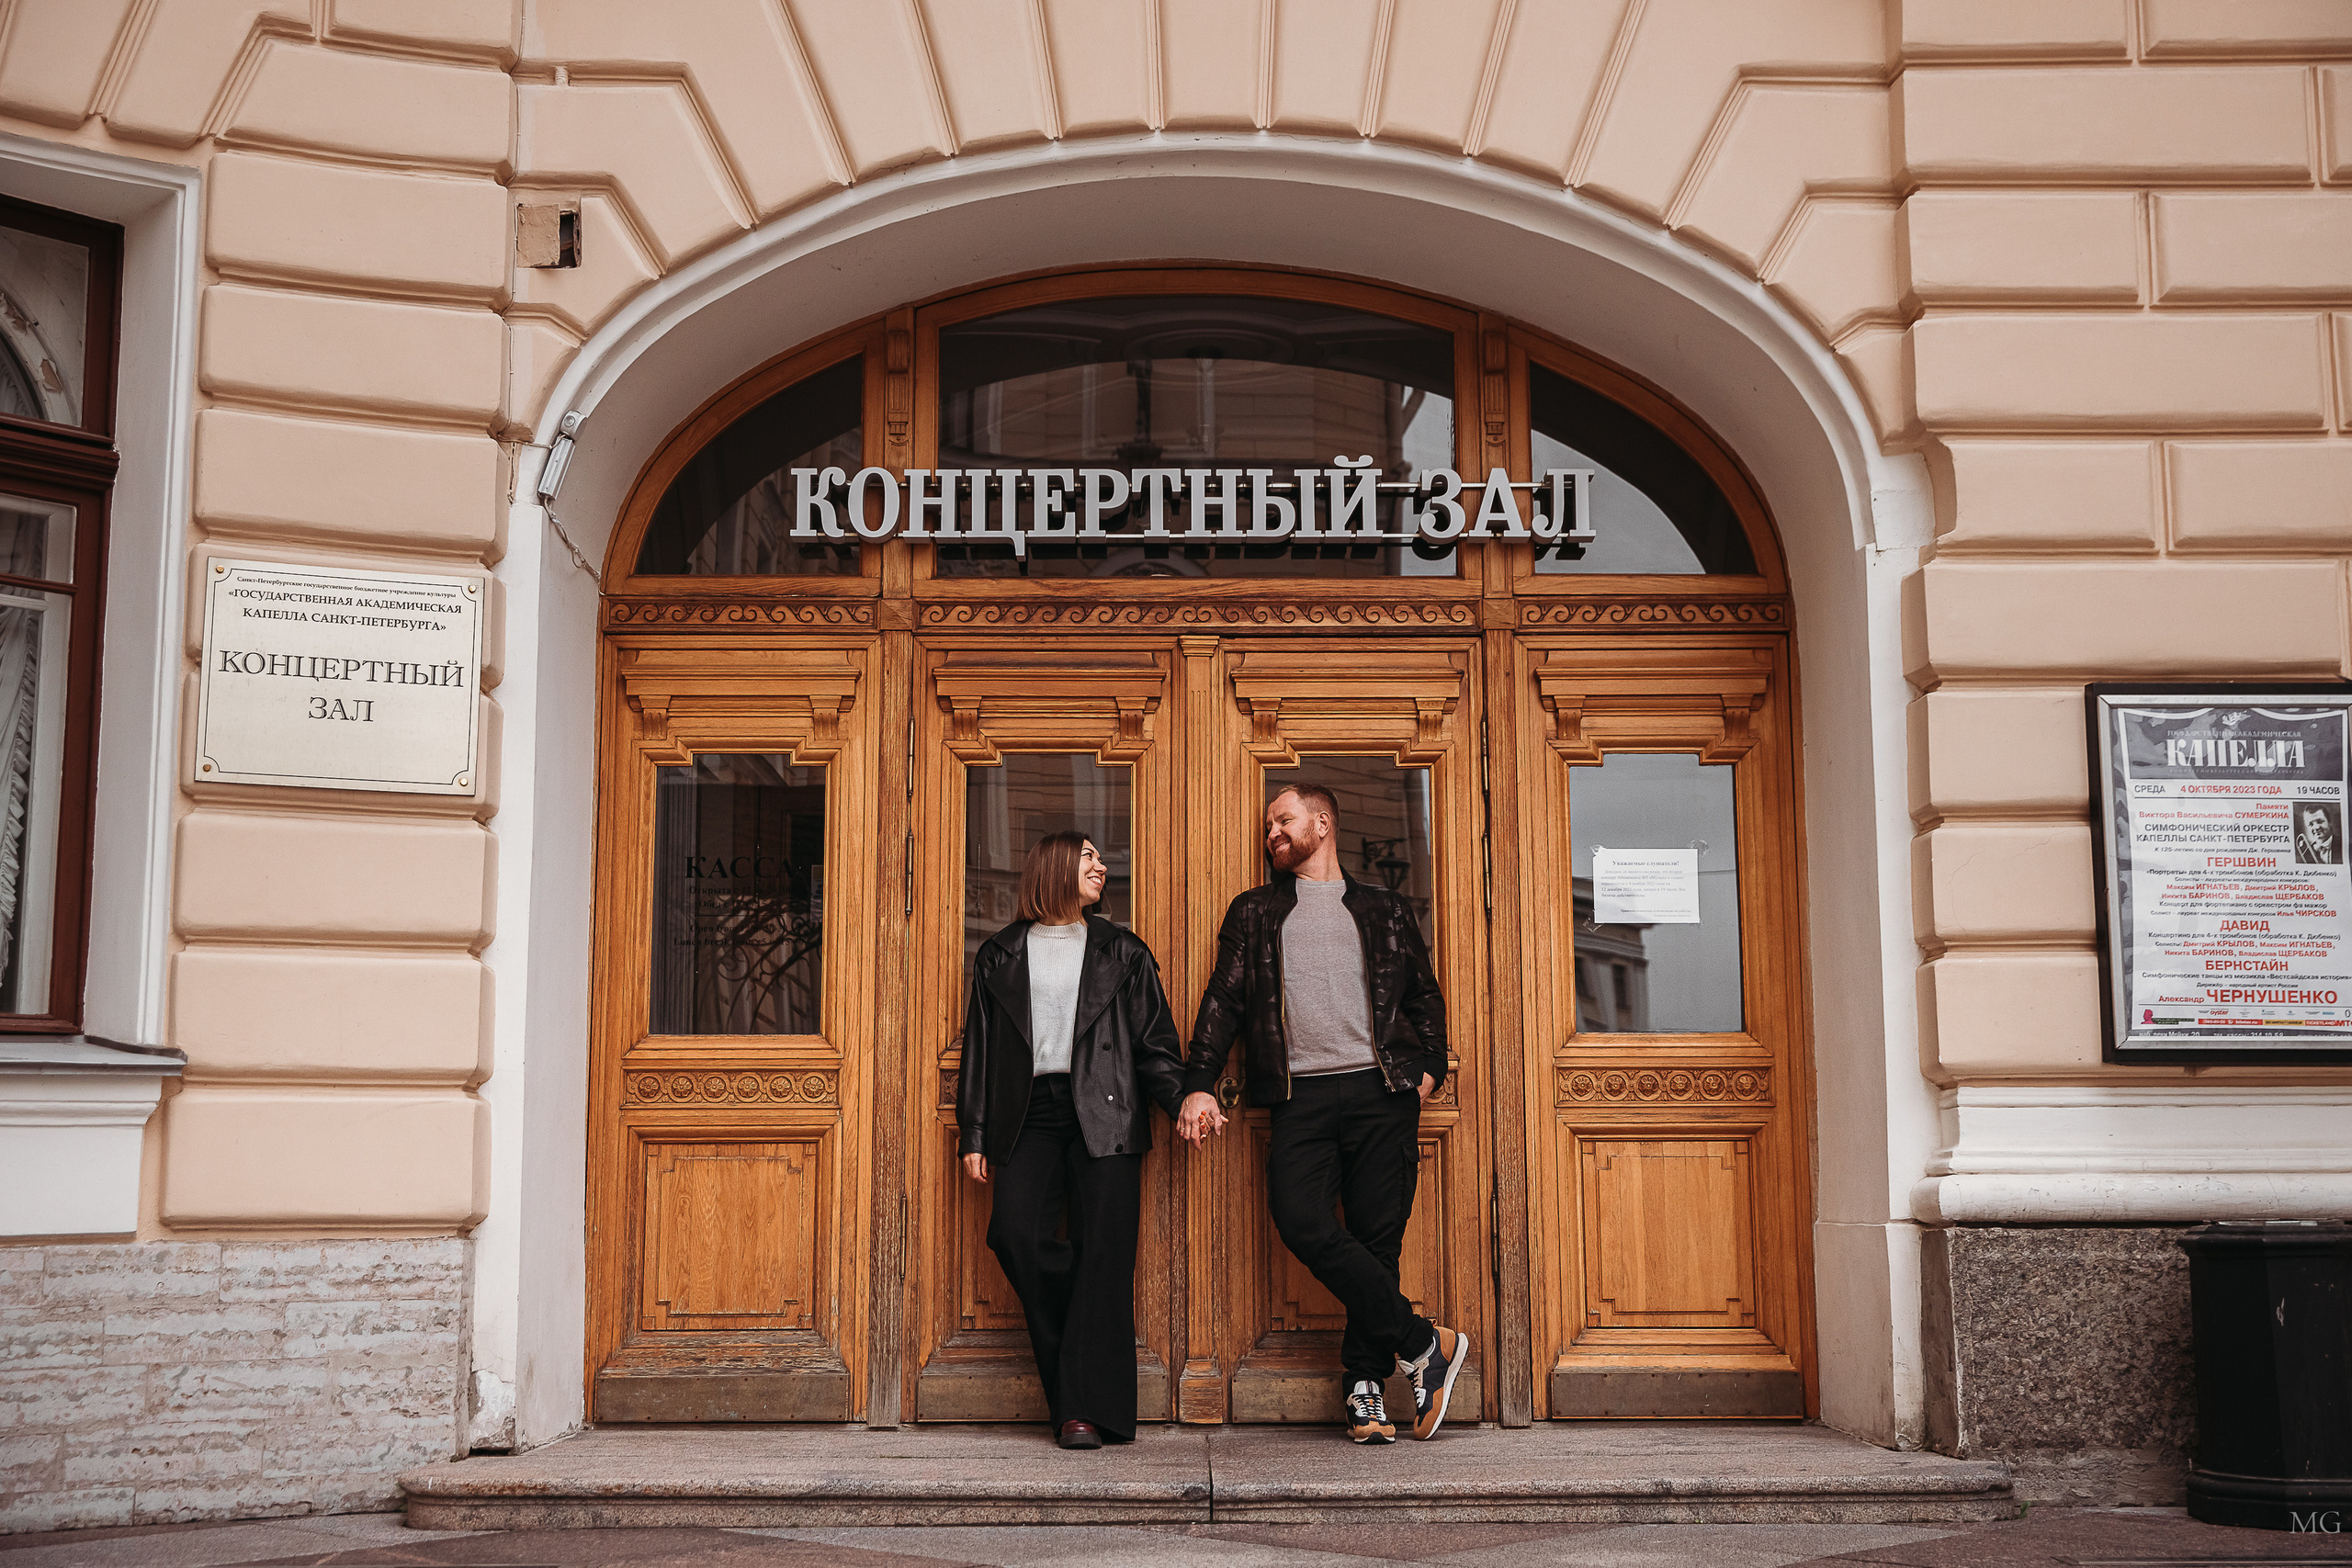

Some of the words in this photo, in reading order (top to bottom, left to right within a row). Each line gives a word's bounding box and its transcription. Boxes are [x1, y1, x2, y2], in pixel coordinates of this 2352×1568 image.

[790, 455, 1384, 562] КОНЦЕРТНЫЙ
[1419, 467, 1596, 544] ЗАЛ
[237, 576, 303, 588] Санкт-Петербургское
[304, 581, 353, 591] государственное
[354, 585, 388, 593] бюджетное
[389, 588, 426, 596] учреждение
[228, 588, 353, 606] «ГОСУДАРСТВЕННАЯ
[356, 597, 462, 614] АКАДЕМИЧЕСКАЯ
[243, 608, 308, 622] КАПЕЛЛА
[311, 613, 446, 631] САНКТ-ПЕТЕРБУРГА»
[219, 649, 464, 688] КОНЦЕРТНЫЙ
[309, 697, 374, 722] ЗАЛ
[2166, 739, 2306, 767] КАПЕЛЛА
[2134, 785, 2165, 794] СРЕДА
[2188, 785, 2231, 794] ОКТЯБРЯ
[2257, 786, 2282, 795] ГОДА
[2309, 787, 2340, 795] ЧАСОВ
[2145, 823, 2240, 832] СИМФОНИЧЕСКИЙ
[2189, 835, 2290, 843] САНКТ-ПЕТЕРБУРГА
[685, 856, 795, 878] КАССА
[2207, 857, 2276, 867] ГЕРШВИН
[689, 887, 731, 895] Окрыта
[2220, 920, 2270, 932] ДАВИД
[2206, 959, 2288, 971] БЕРНСТАЙН
[2206, 990, 2337, 1003] ЧЕРНУШЕНКО
